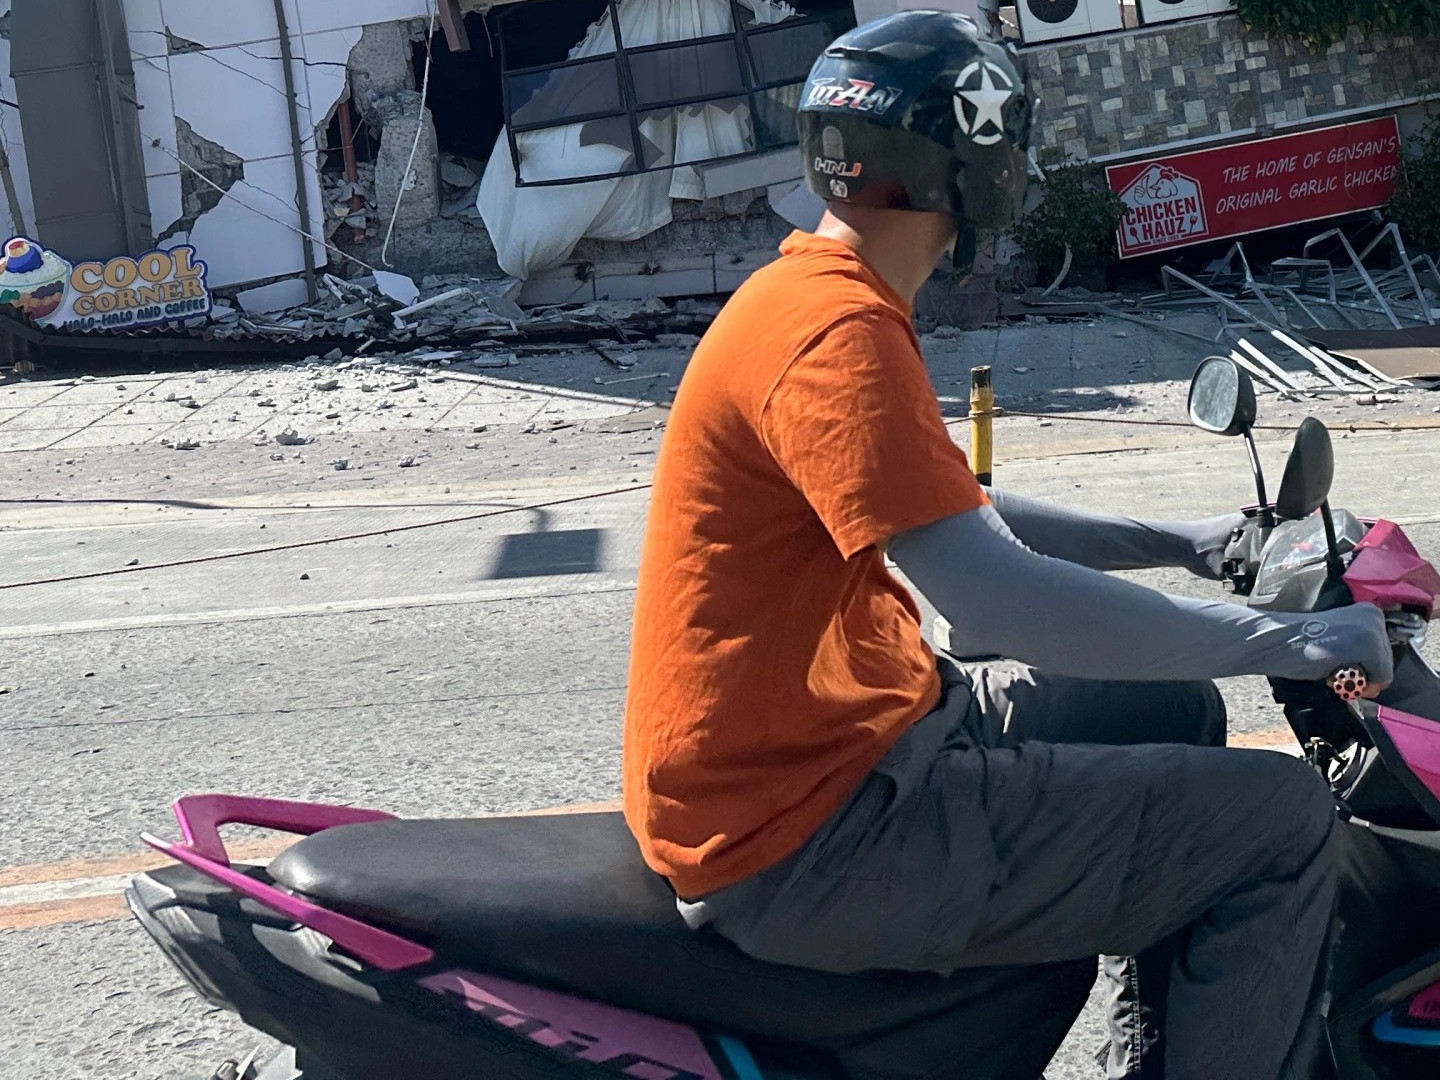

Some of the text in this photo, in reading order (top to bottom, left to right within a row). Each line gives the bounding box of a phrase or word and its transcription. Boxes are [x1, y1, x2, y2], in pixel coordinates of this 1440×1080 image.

[1222, 136, 1397, 184] THE HOME OF GENSAN'S
[1125, 196, 1197, 226] CHICKEN
[1215, 188, 1282, 215] ORIGINAL
[1289, 176, 1338, 199] GARLIC
[1141, 216, 1186, 240] HAUZ
[70, 248, 201, 294] COOL
[73, 277, 204, 316] CORNER
[137, 307, 161, 320] AND
[165, 298, 206, 315] COFFEE
